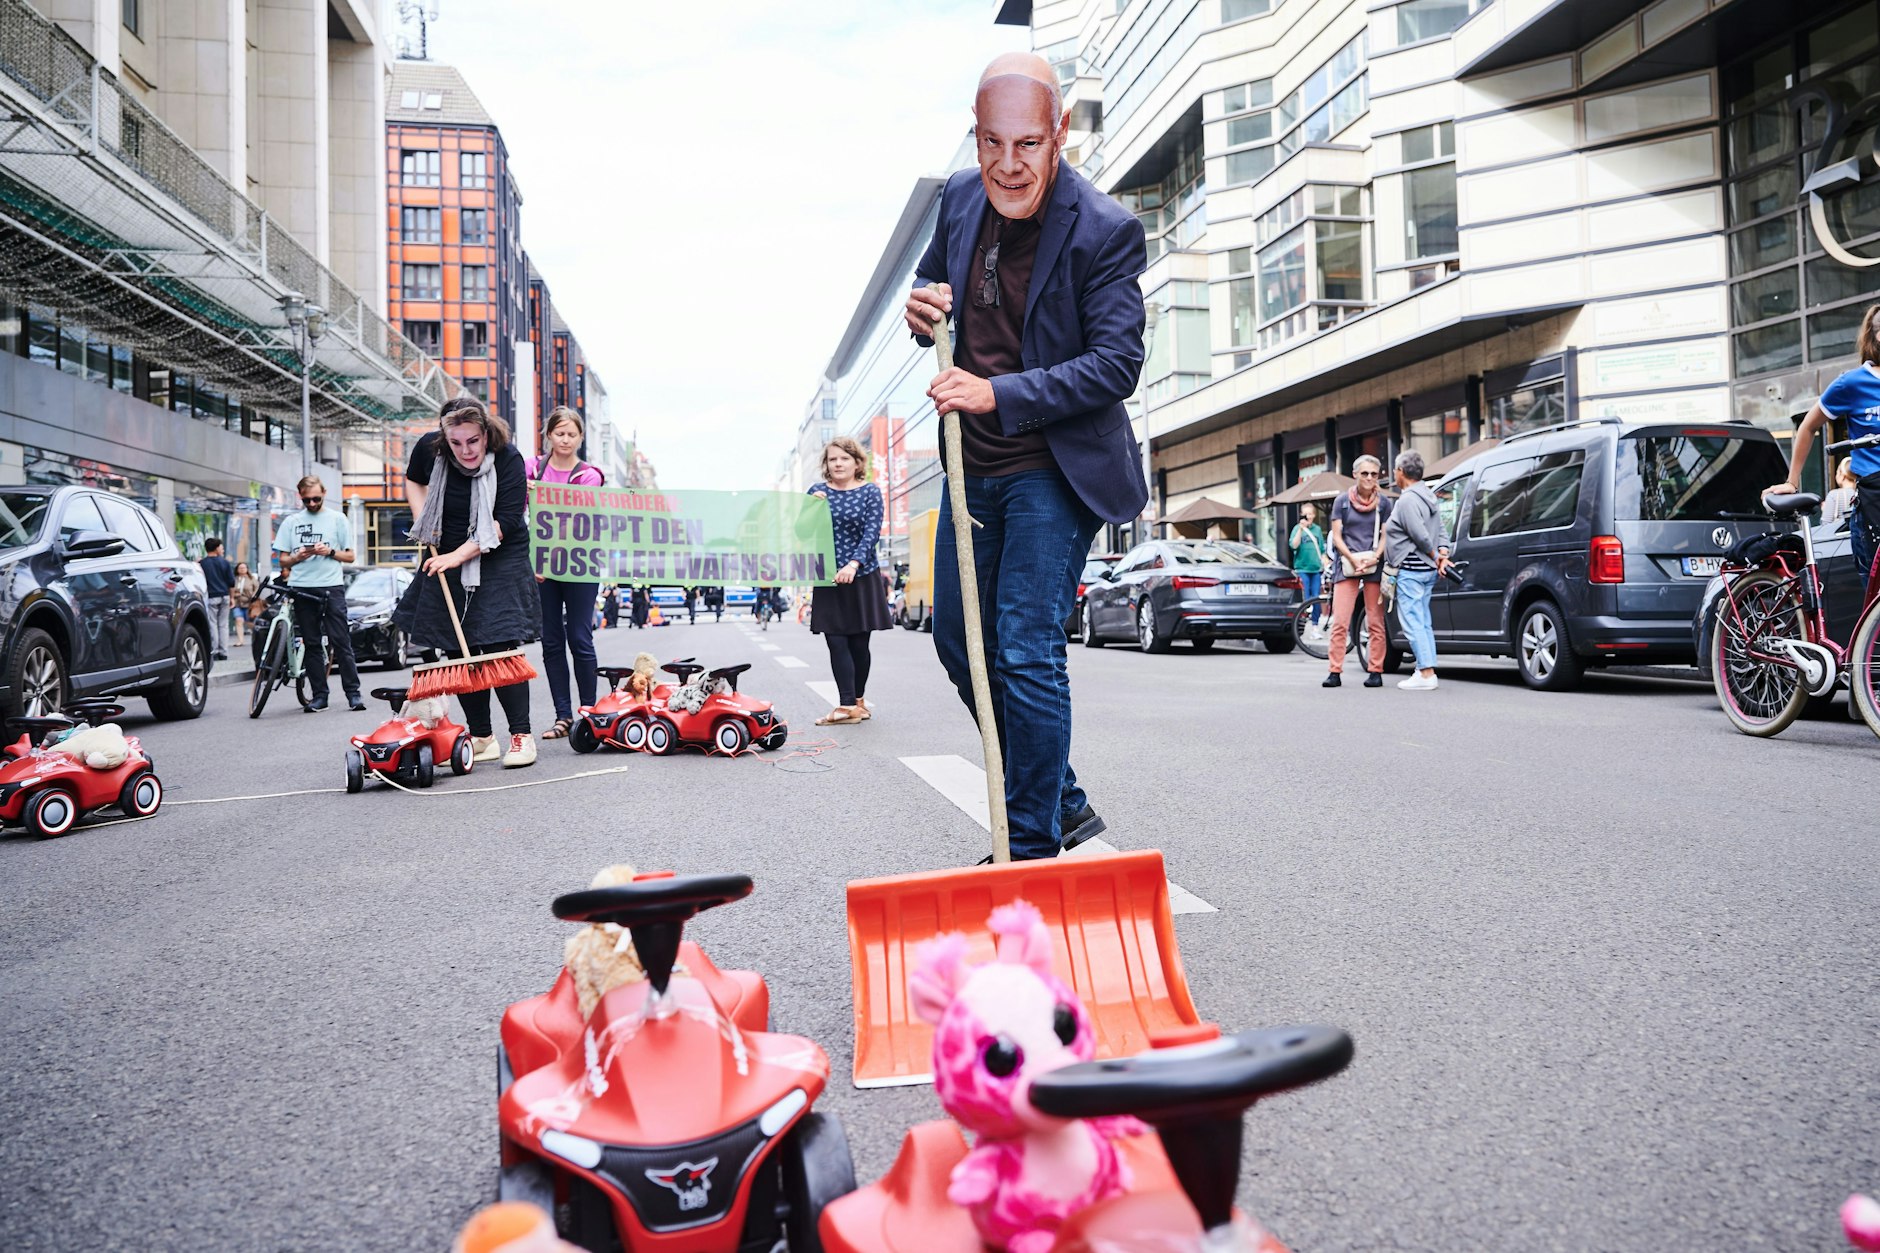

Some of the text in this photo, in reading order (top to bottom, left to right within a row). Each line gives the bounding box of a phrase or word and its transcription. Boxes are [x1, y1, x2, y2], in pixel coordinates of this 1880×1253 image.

[536, 487, 596, 507] ELTERN
[536, 511, 704, 546] STOPPT DEN
[536, 547, 825, 581] FOSSILEN WAHNSINN
[1690, 558, 1699, 571] B
